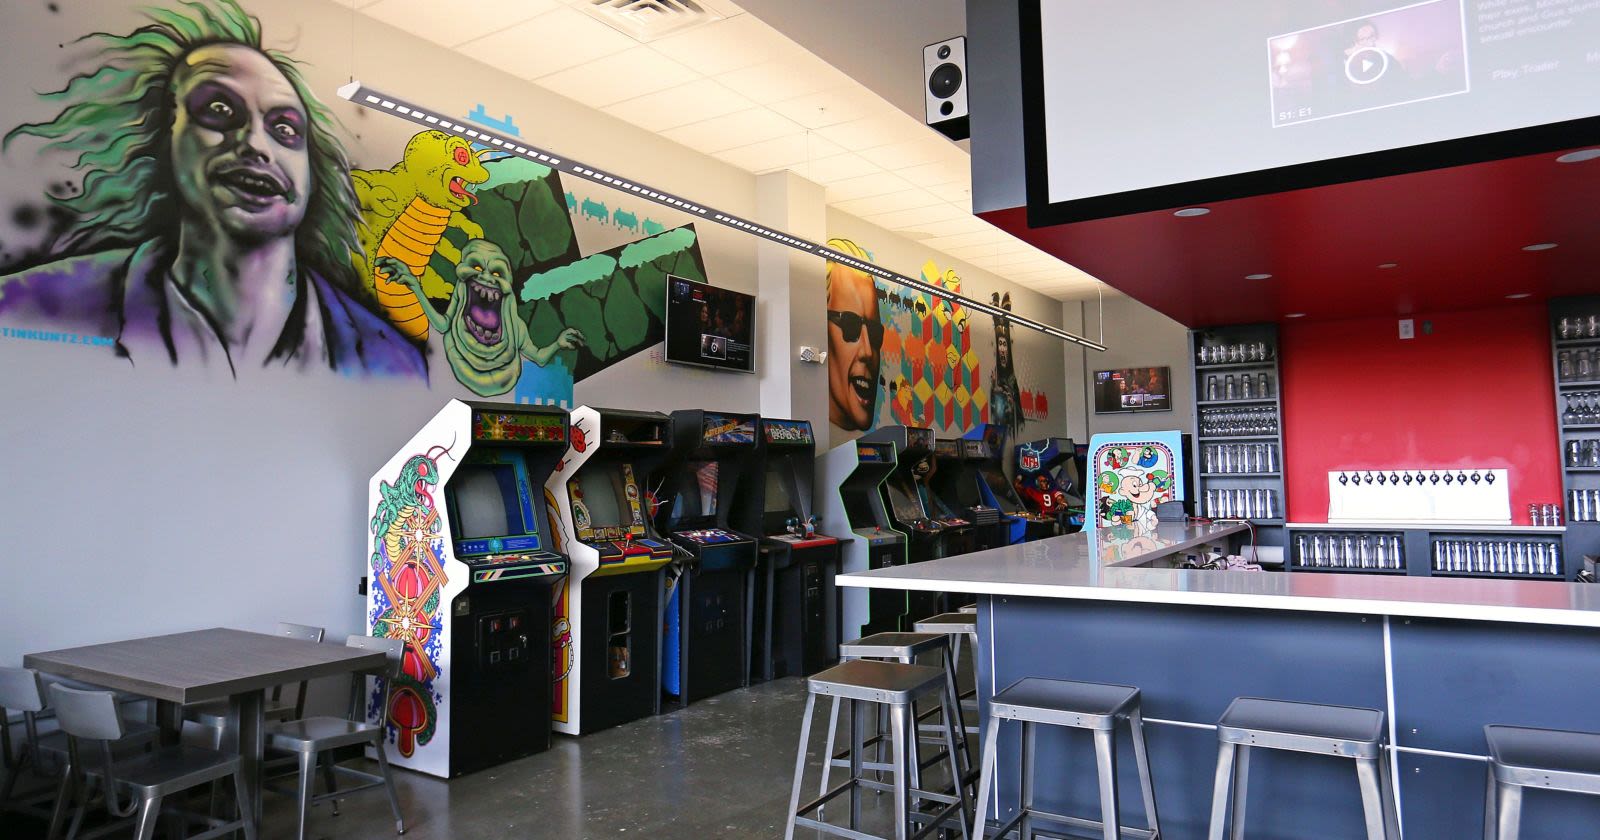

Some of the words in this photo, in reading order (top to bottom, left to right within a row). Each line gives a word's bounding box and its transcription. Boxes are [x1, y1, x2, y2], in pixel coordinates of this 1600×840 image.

[1491, 68, 1519, 80] Play
[1279, 111, 1296, 121] S1:
[1299, 107, 1312, 117] E1
[0, 327, 113, 347] TINKUNTZ.COM
[1043, 493, 1052, 508] 9
